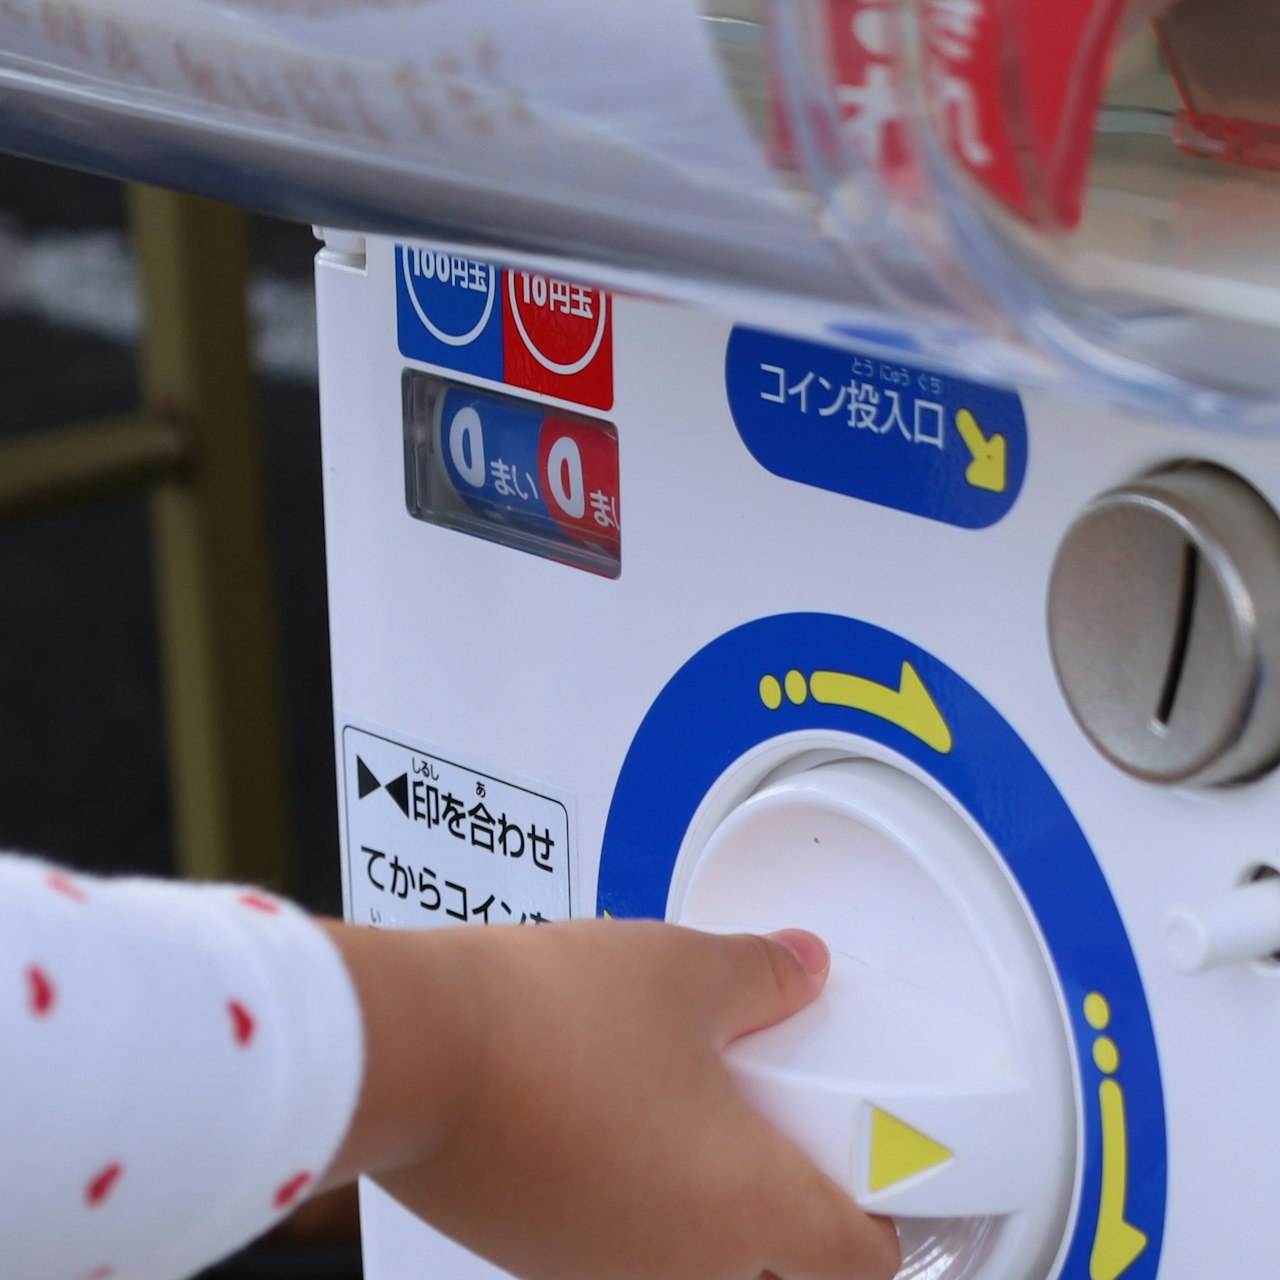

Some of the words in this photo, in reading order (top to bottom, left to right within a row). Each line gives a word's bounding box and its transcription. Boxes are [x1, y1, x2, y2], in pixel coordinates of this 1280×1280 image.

[410, 247, 488, 293] 100円玉
[521, 272, 593, 319] 10円玉
[760, 362, 944, 450] コイン投入口
[412, 780, 554, 873] 印を合わせ
